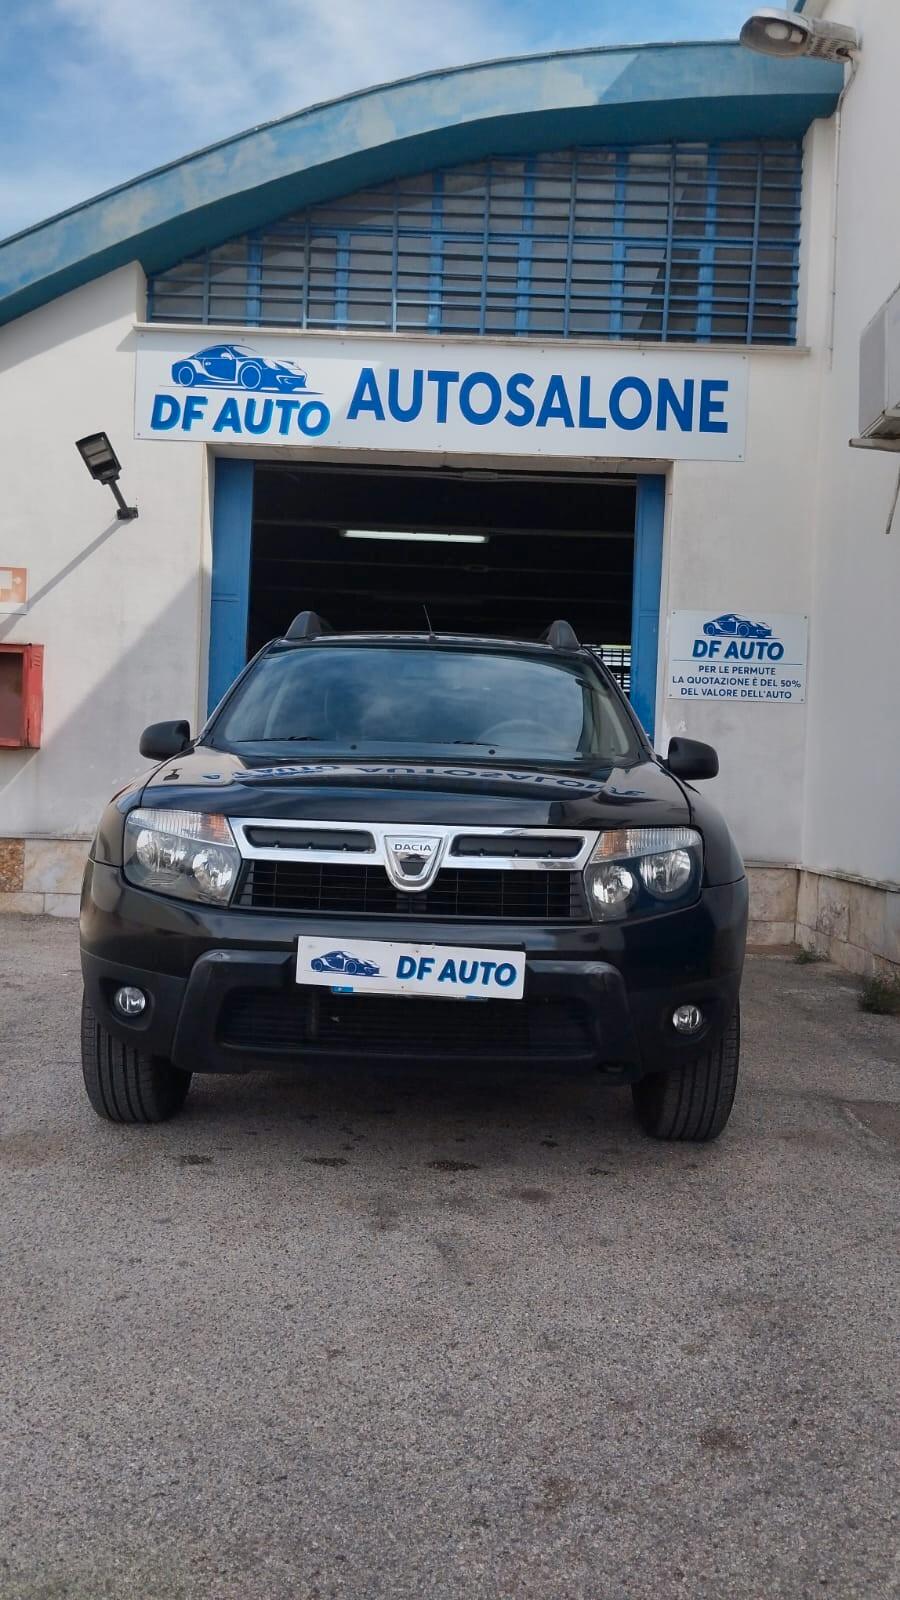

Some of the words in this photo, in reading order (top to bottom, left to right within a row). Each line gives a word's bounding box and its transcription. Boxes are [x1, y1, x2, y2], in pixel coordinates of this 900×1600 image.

[346, 367, 730, 434] AUTOSALONE
[150, 394, 208, 432] DF
[212, 397, 332, 438] AUTO
[692, 639, 721, 659] DF
[724, 641, 784, 661] AUTO
[698, 665, 716, 674] PER
[719, 665, 729, 674] LE
[732, 666, 776, 676] PERMUTE
[672, 676, 683, 684] LA
[687, 676, 750, 686] QUOTAZIONE
[760, 679, 778, 688] DEL
[780, 680, 802, 689] 50%
[681, 687, 698, 696] DEL
[701, 688, 738, 698] VALORE
[740, 689, 792, 699] DELL'AUTO
[394, 843, 432, 852] DACIA
[396, 955, 435, 981] DF
[438, 957, 518, 987] AUTO
